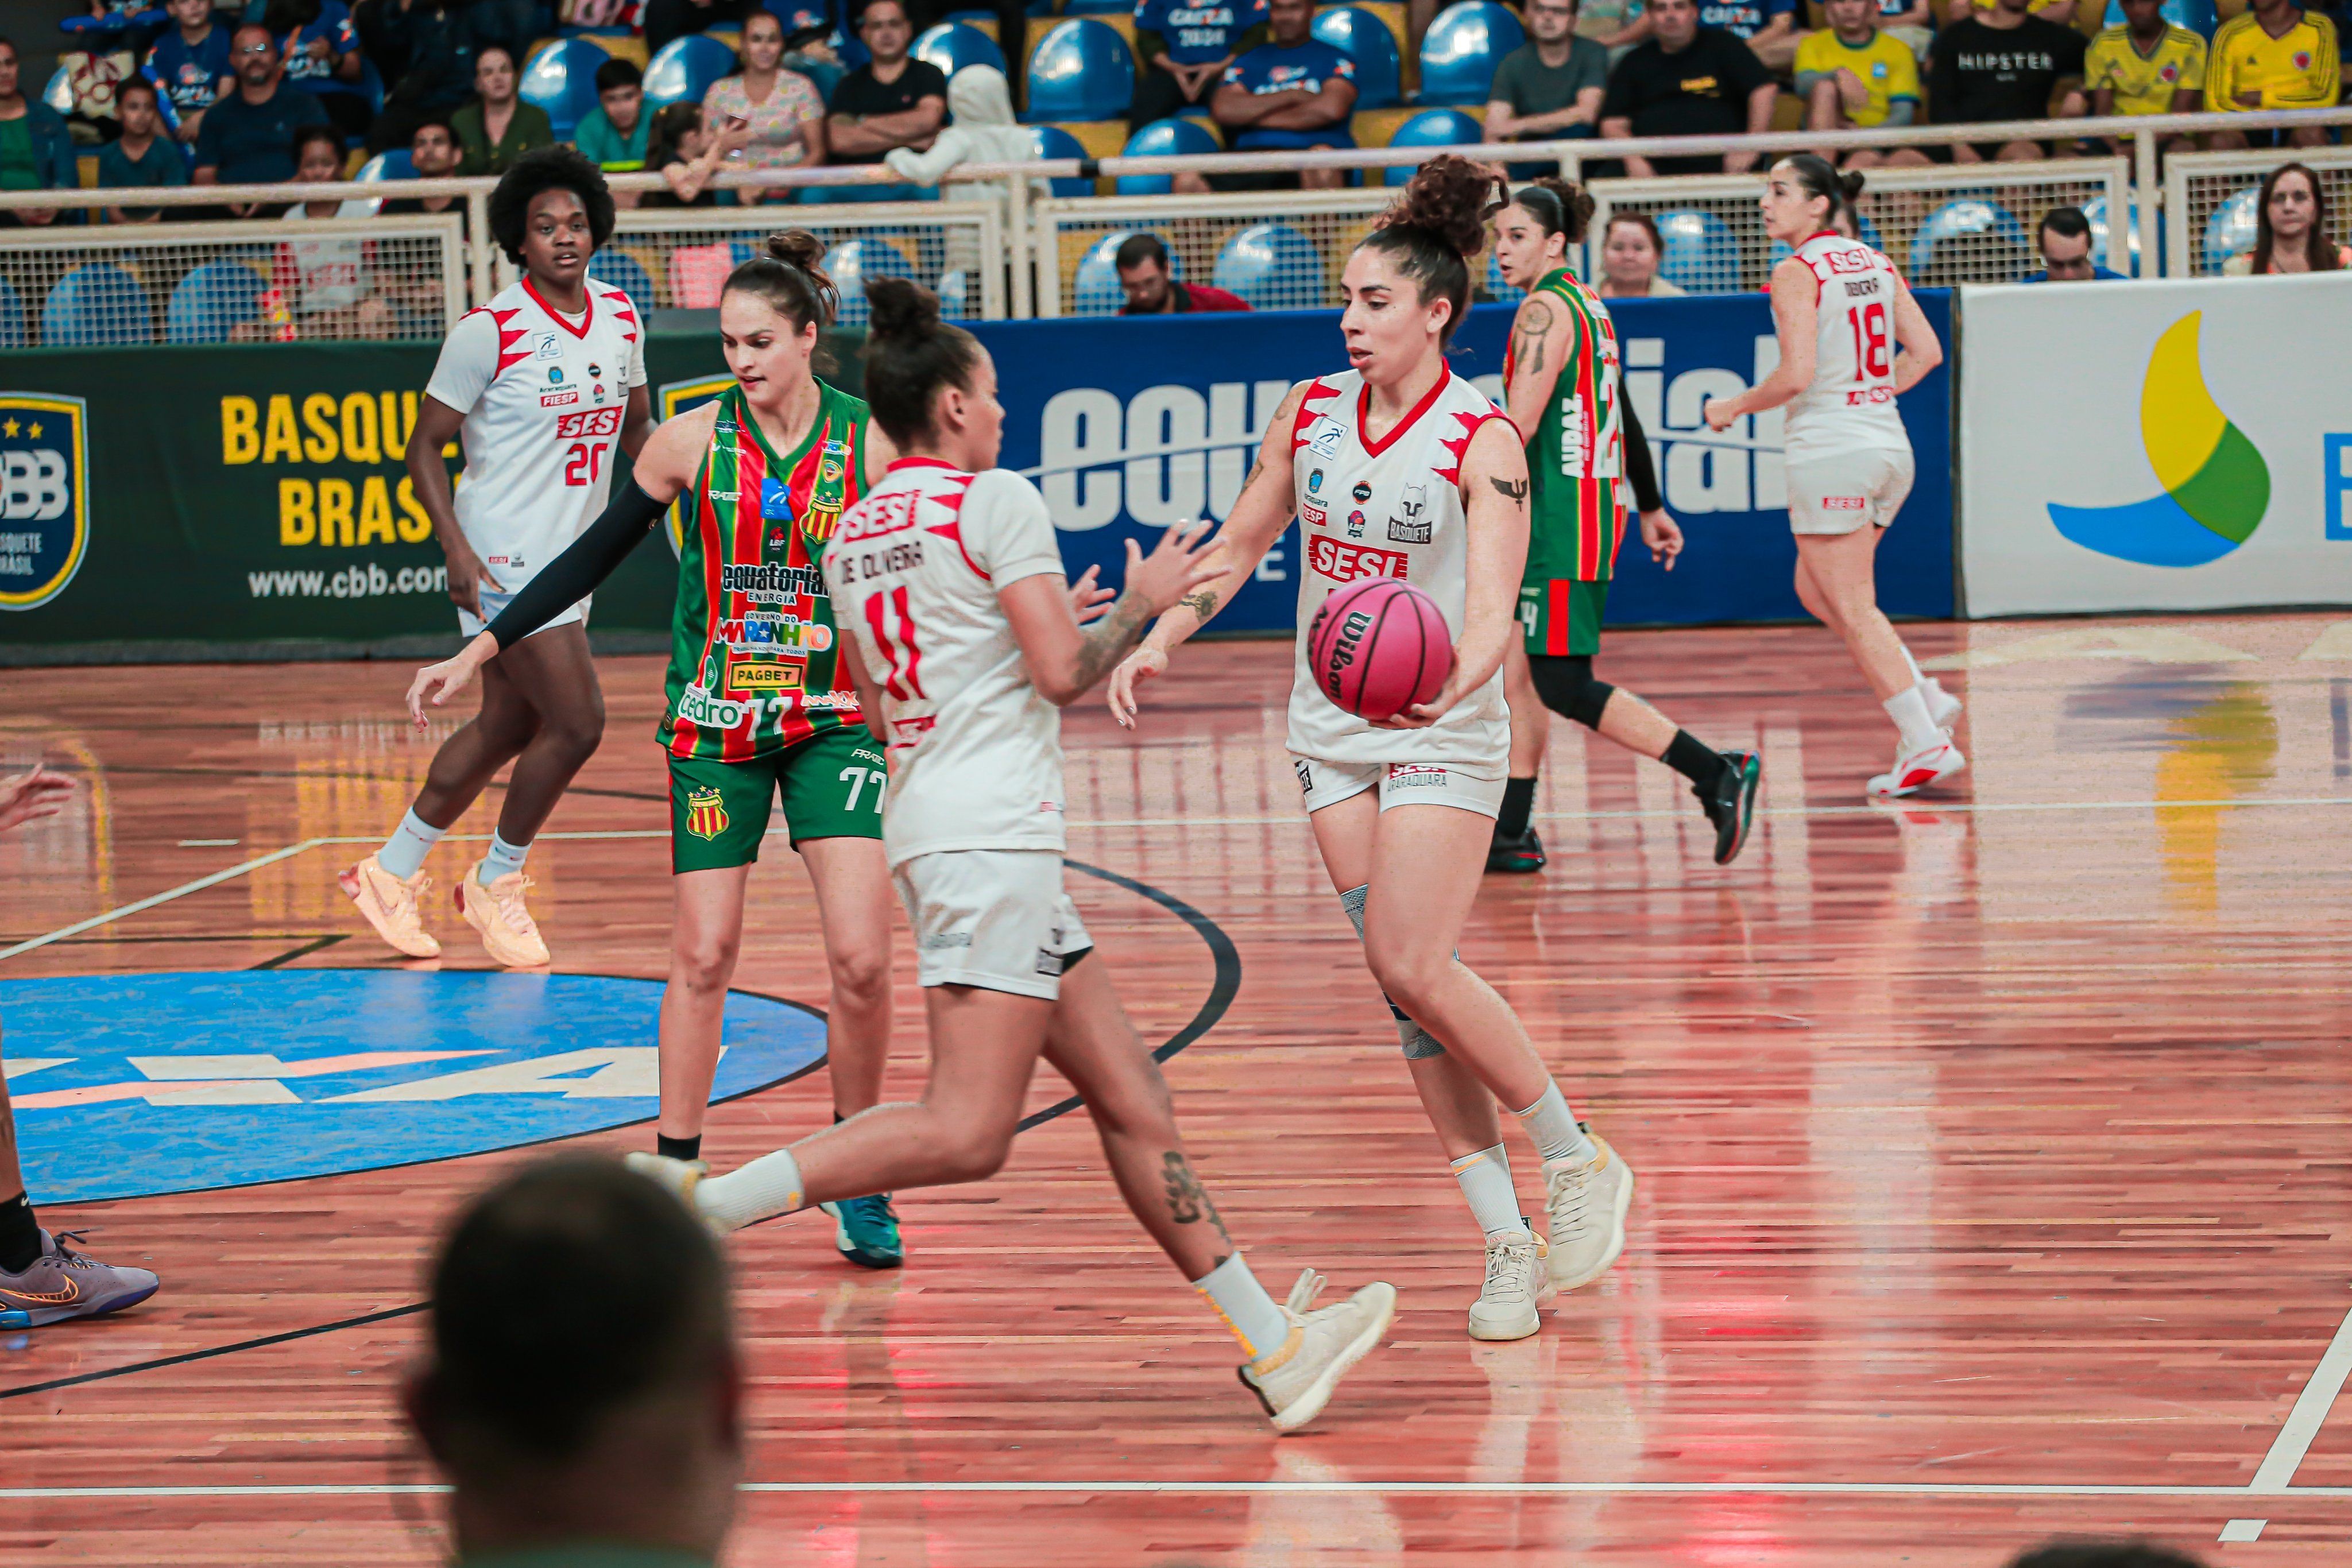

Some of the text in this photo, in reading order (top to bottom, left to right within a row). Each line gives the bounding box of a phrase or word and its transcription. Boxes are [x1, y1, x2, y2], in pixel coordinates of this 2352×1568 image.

[1958, 52, 2052, 70] HIPSTER
[1848, 303, 1889, 381] 18
[543, 393, 577, 406] FIESP
[221, 391, 458, 465] BASQU
[1562, 393, 1585, 479] AUDAZ
[0, 448, 69, 520] BB
[1317, 540, 1397, 580] SESI
[746, 611, 780, 621] GOVERNO
[748, 592, 796, 604] ENERGIA
[717, 621, 830, 649] MARANHÃO
[865, 586, 926, 702] 11
[1328, 611, 1375, 699] Wilson
[738, 670, 792, 681] PAGBET
[681, 692, 738, 725] cedro
[744, 696, 793, 741] 77
[839, 766, 888, 814] 77
